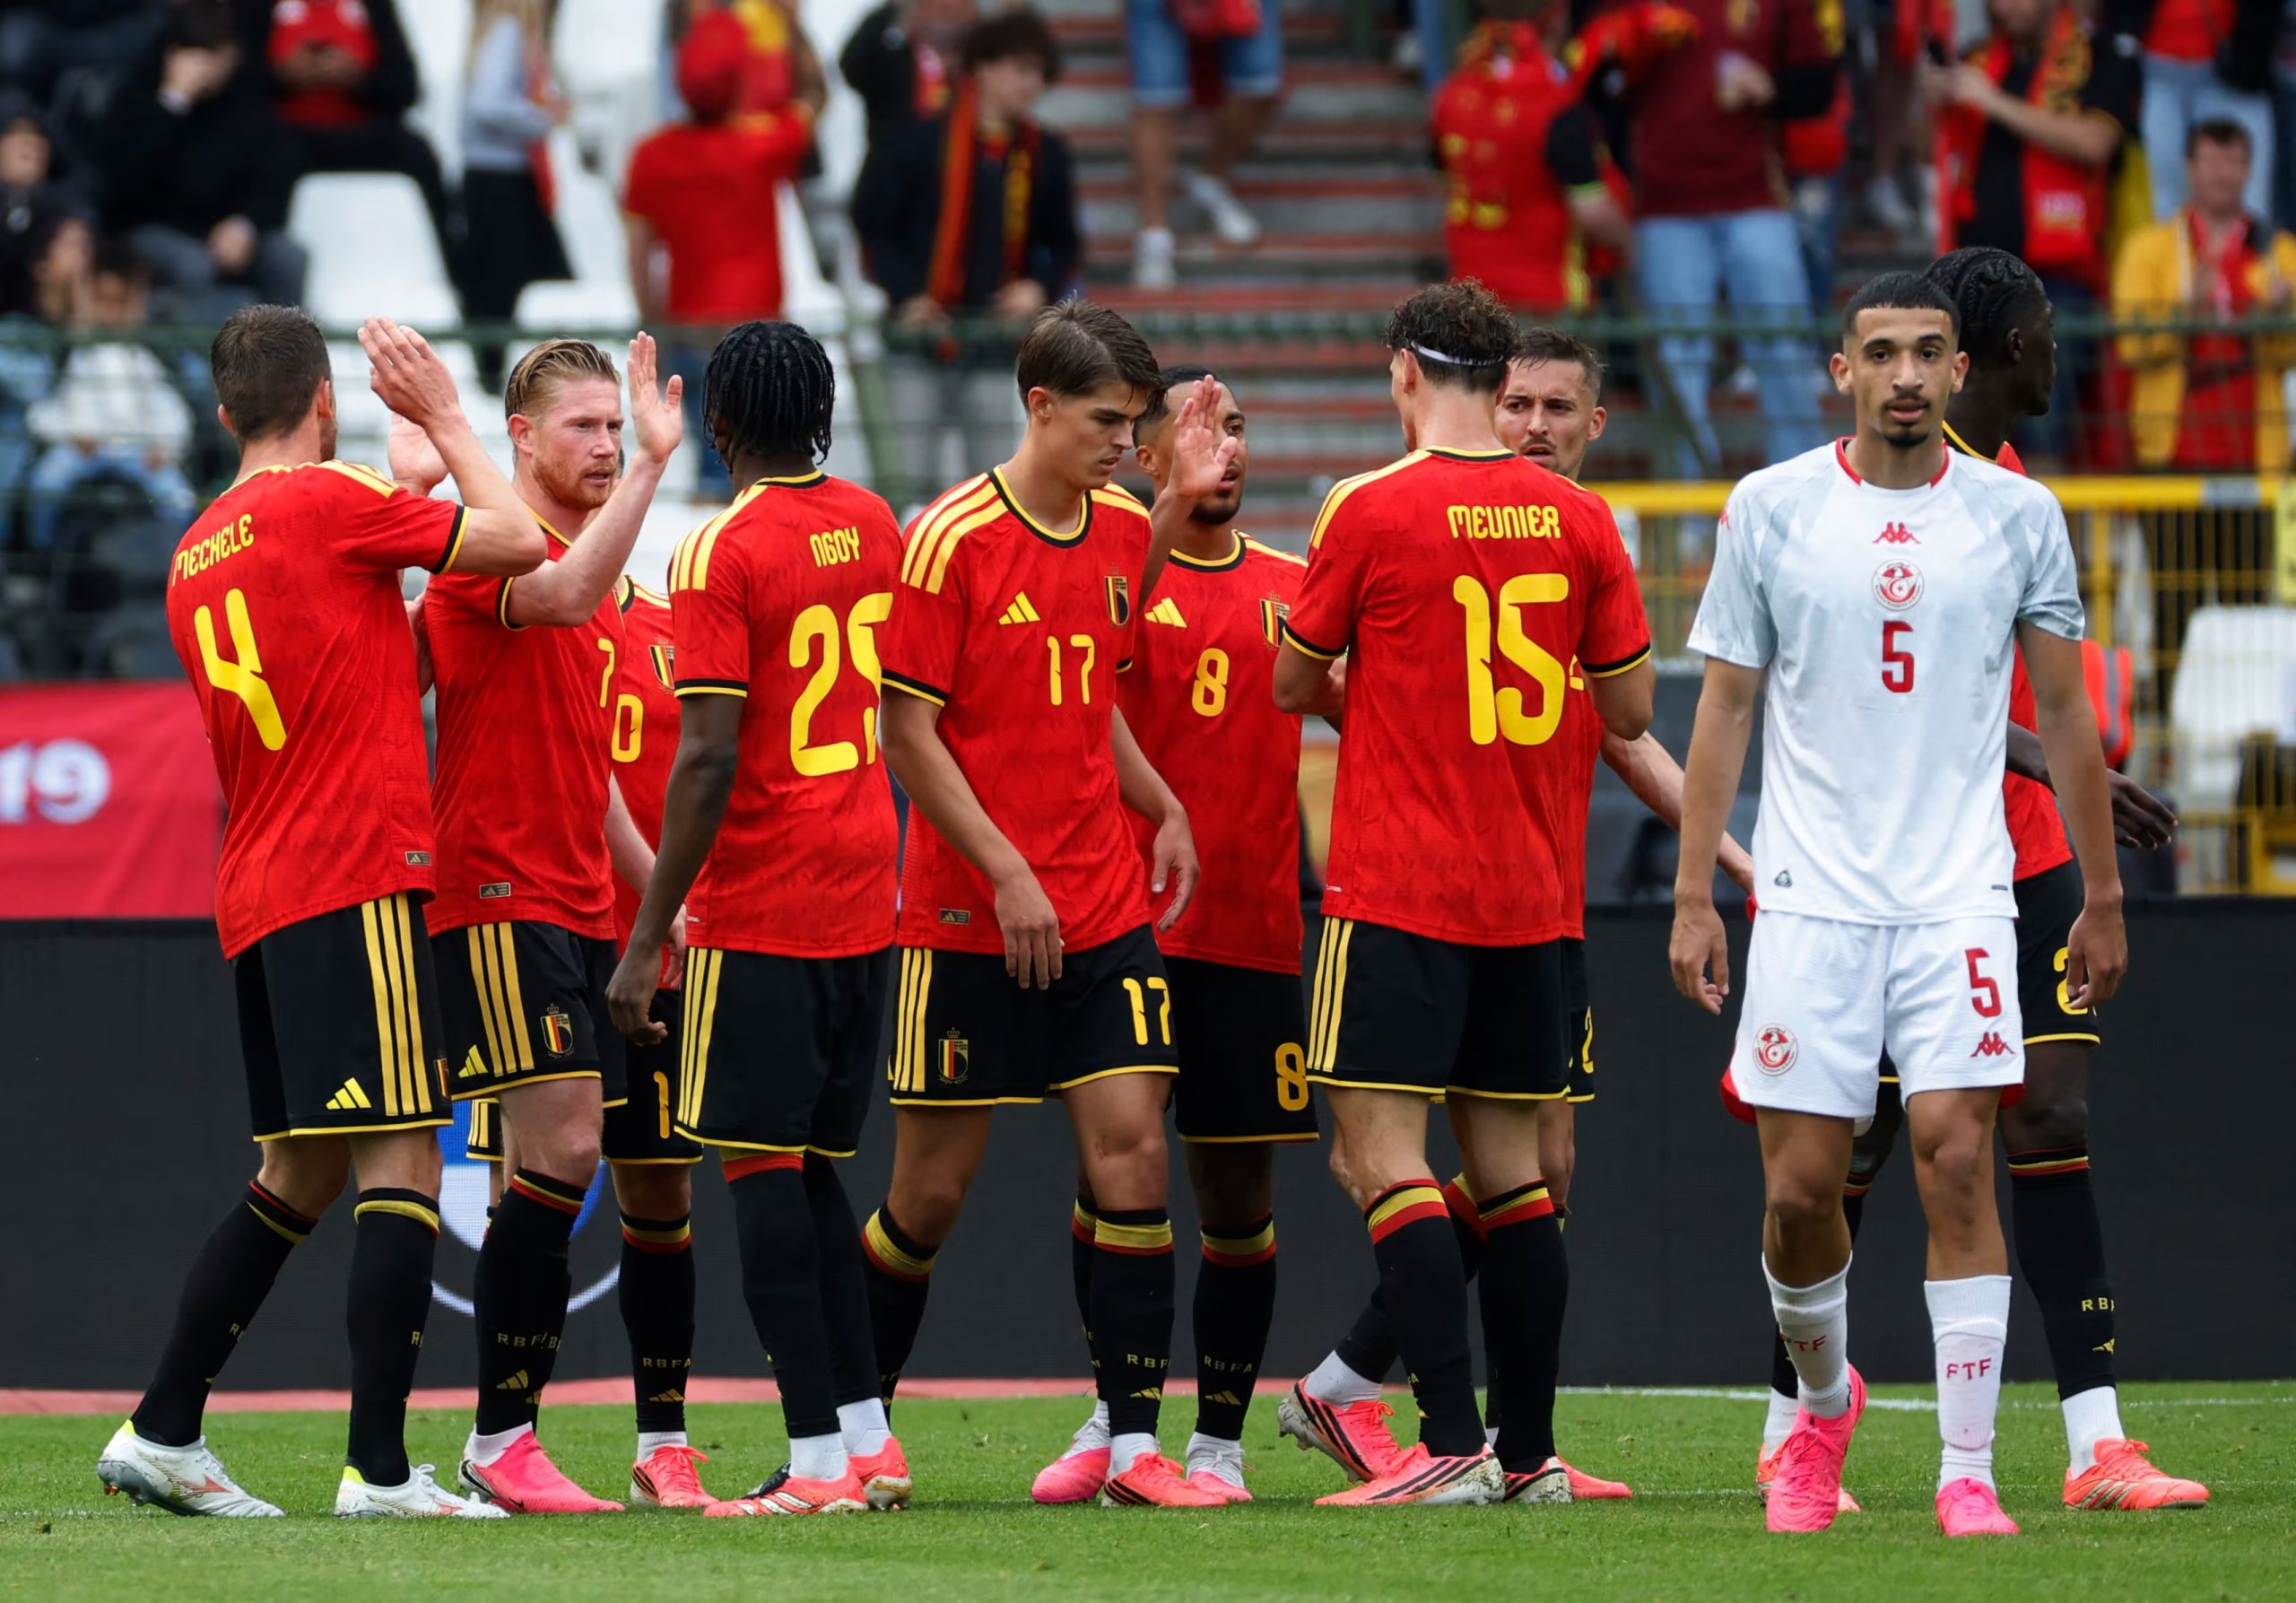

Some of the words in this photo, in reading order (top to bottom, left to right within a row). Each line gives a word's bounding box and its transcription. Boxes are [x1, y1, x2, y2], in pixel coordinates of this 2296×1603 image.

[172, 514, 254, 588] MECHELE
[809, 527, 861, 568] NGOY
[1447, 505, 1561, 539] MEUNIER
[194, 588, 288, 752] 4
[596, 637, 615, 709] 7
[1047, 634, 1095, 706] 17
[1192, 648, 1230, 718] 8
[1453, 573, 1569, 745] 15
[1882, 620, 1916, 693] 5
[1123, 976, 1171, 1046] 17
[1964, 947, 2003, 1018] 5
[1275, 1042, 1309, 1111] 8
[1204, 1355, 1254, 1373] RBFA
[1946, 1357, 1992, 1381] FTF
